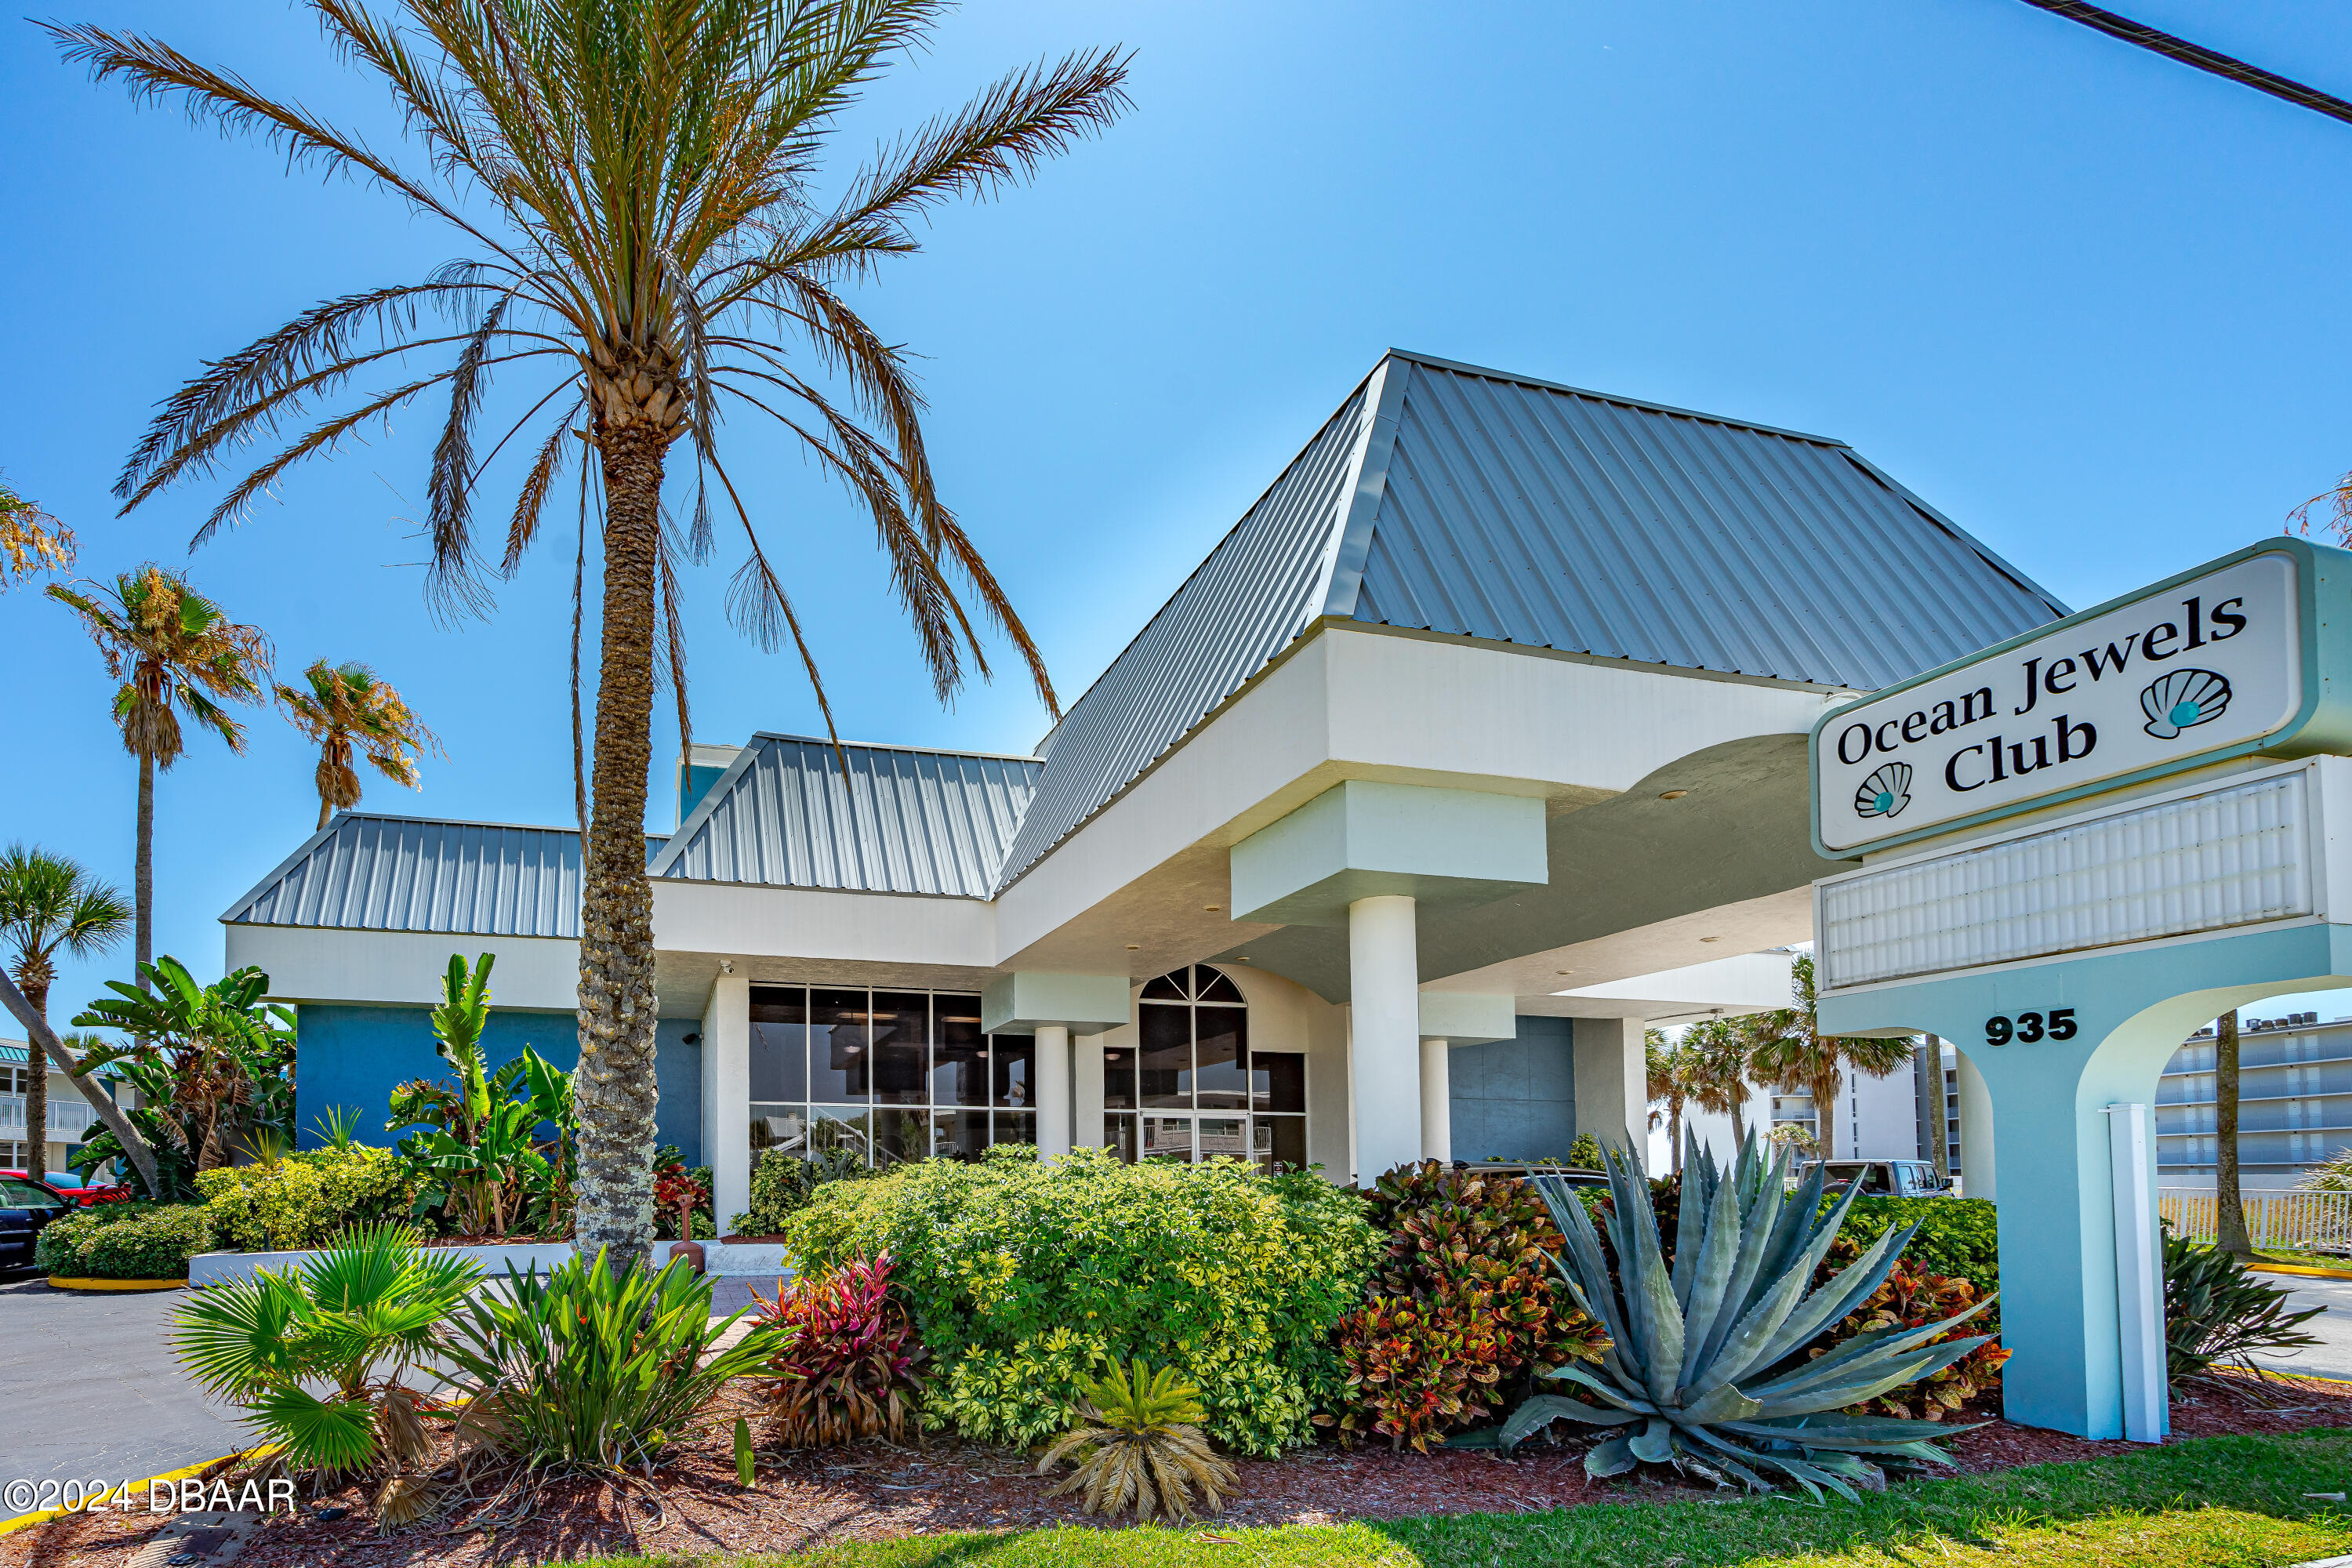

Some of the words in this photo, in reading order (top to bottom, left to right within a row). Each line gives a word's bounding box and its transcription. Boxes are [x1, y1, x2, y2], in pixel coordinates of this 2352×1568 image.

[1838, 687, 1998, 765] Ocean
[2014, 596, 2248, 716] Jewels
[1944, 713, 2097, 793] Club
[1984, 1007, 2078, 1047] 935
